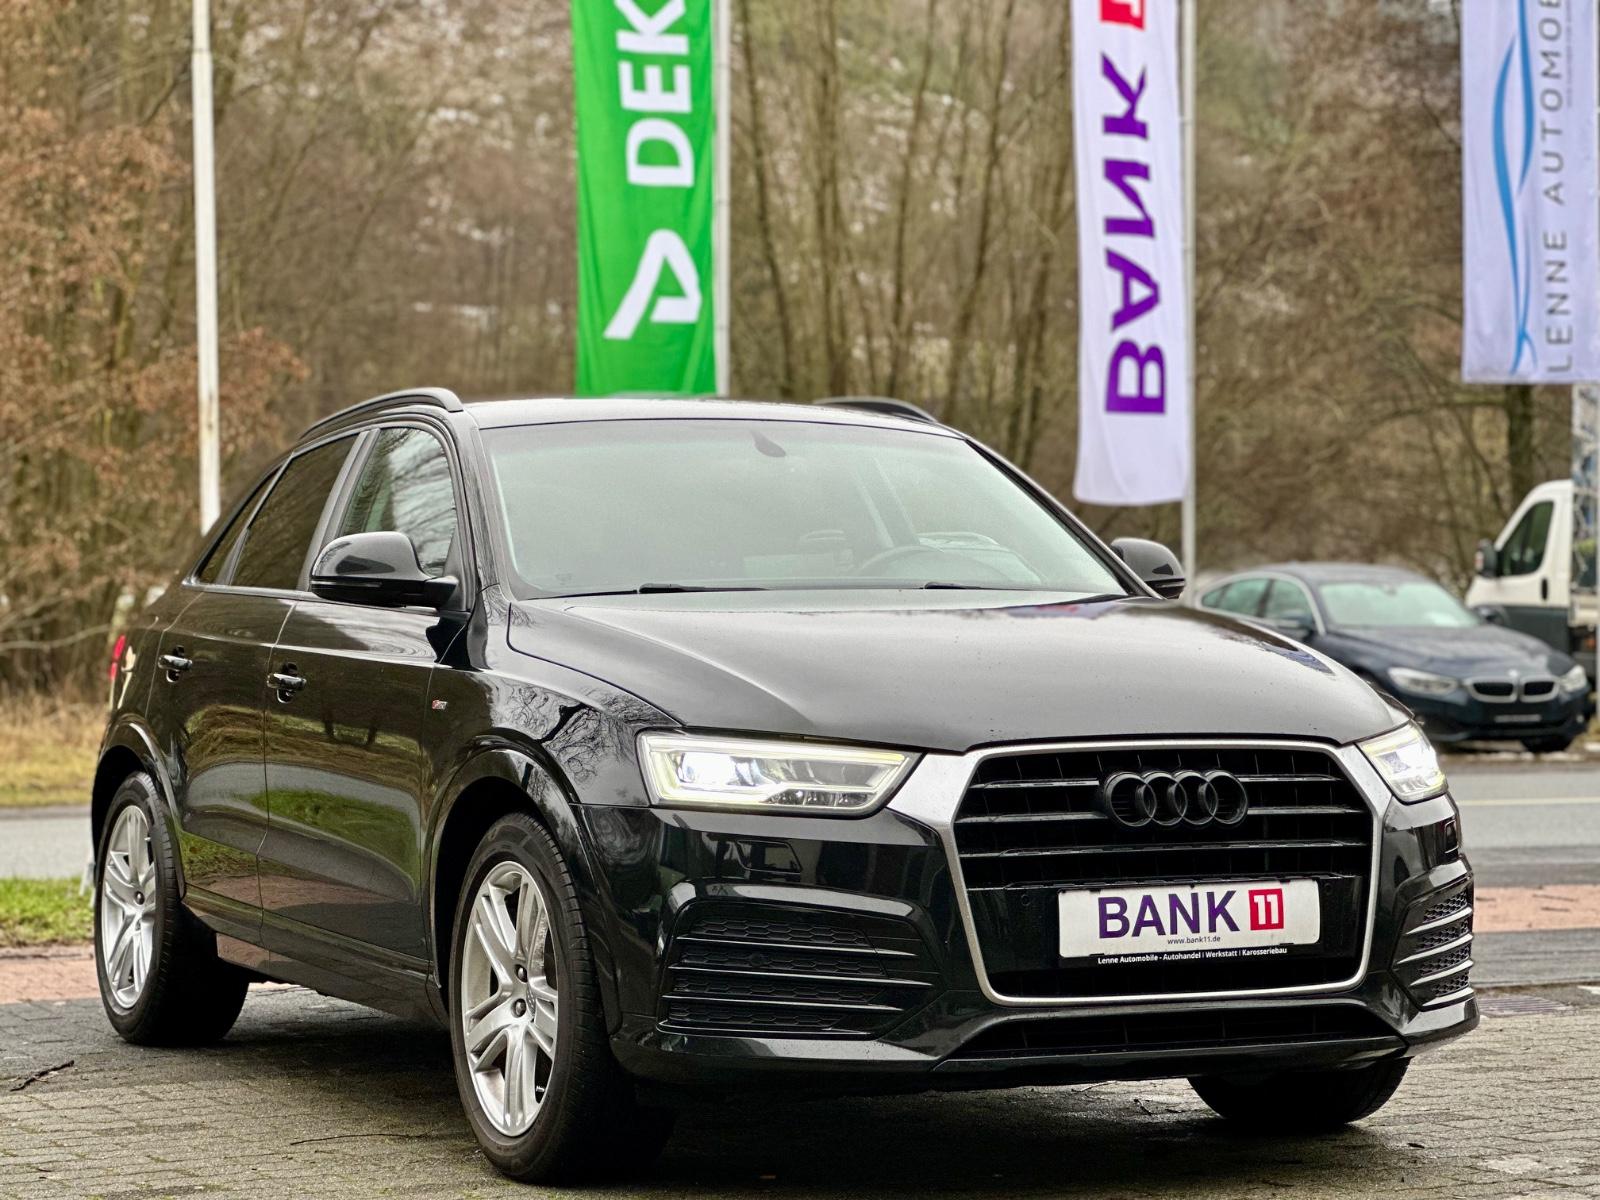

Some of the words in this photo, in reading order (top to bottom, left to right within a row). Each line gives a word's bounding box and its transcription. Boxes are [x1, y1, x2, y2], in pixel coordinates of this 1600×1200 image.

[1543, 229, 1573, 373] LENNE
[1098, 890, 1240, 939] BANK
[1252, 892, 1281, 927] 11
[1097, 957, 1118, 965] Lenne
[1119, 954, 1158, 963] Automobile
[1162, 952, 1201, 960] Autohandel
[1205, 950, 1238, 958] Werkstatt
[1242, 947, 1288, 956] Karosseriebau
[1167, 935, 1221, 945] www.bank11.de
